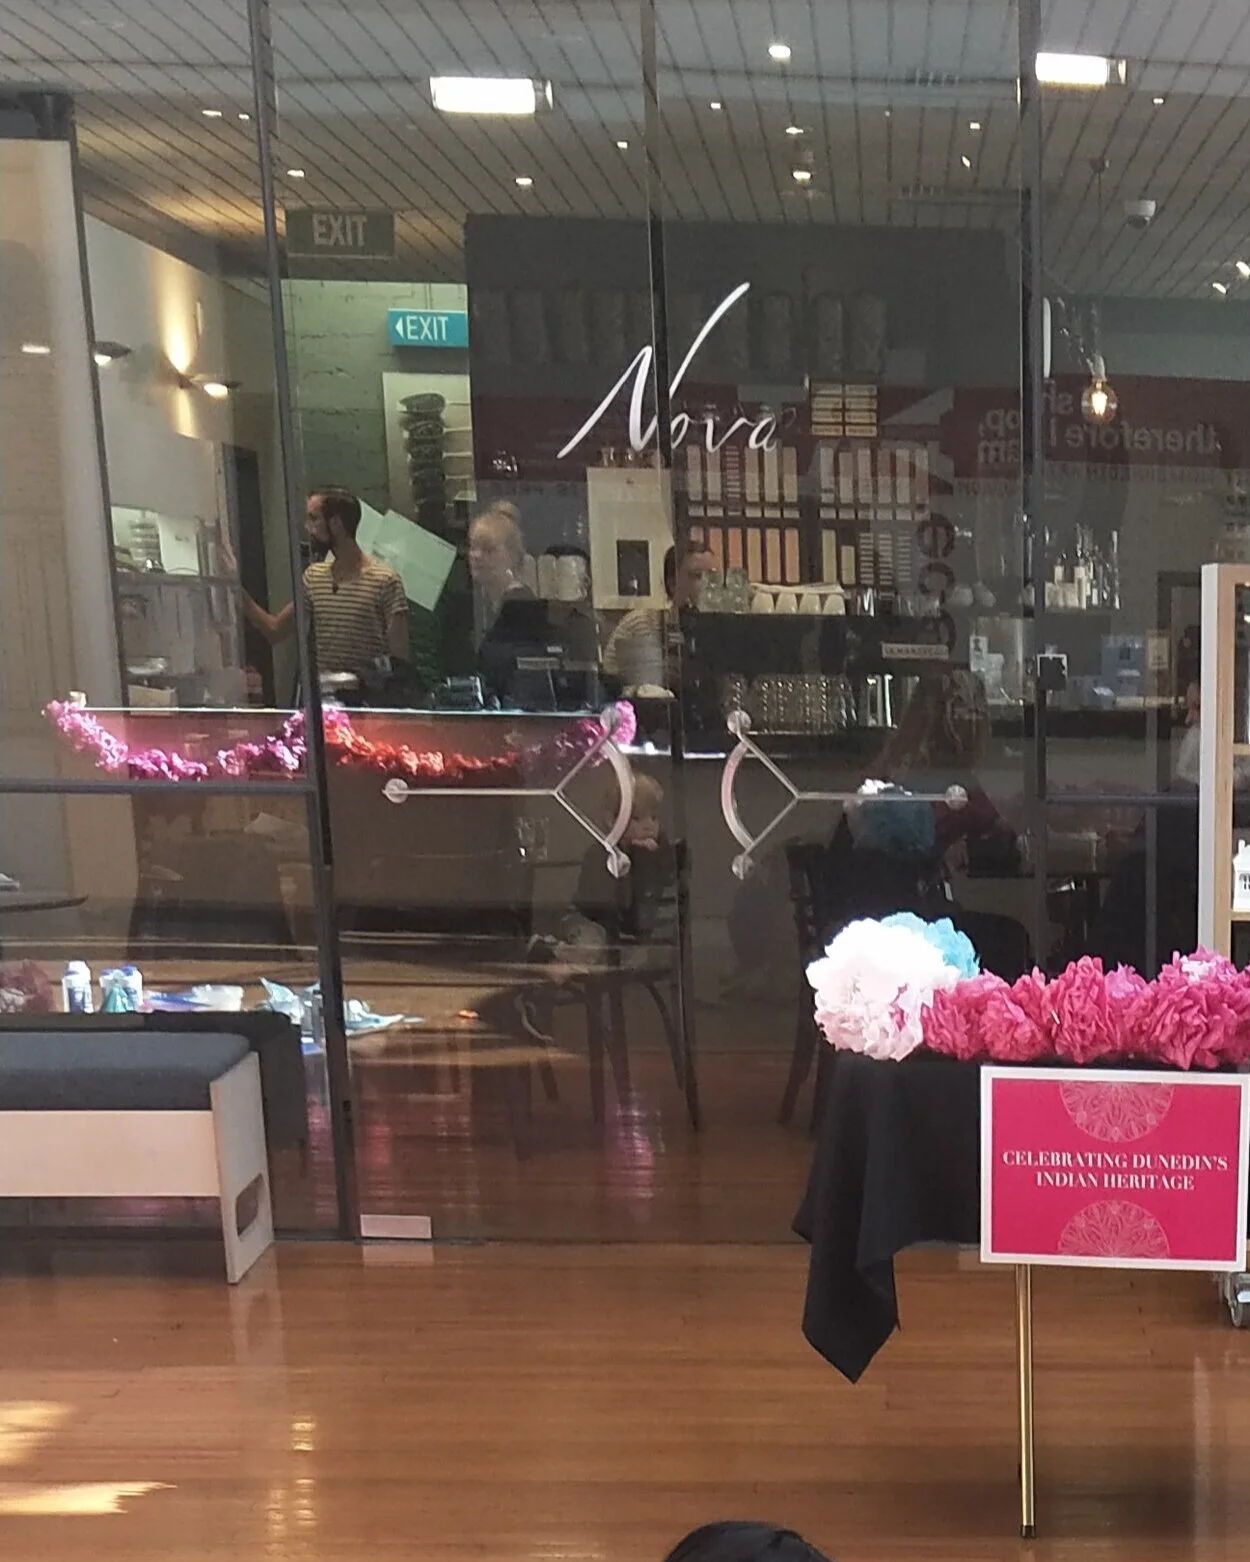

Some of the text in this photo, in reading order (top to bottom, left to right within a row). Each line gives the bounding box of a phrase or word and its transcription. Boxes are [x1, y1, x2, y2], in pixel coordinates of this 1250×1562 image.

[312, 213, 367, 247] EXIT
[405, 315, 449, 341] EXIT
[557, 281, 778, 459] Nova
[1002, 1150, 1228, 1171] CELEBRATING DUNEDIN'S
[1036, 1171, 1195, 1191] INDIAN HERITAGE
